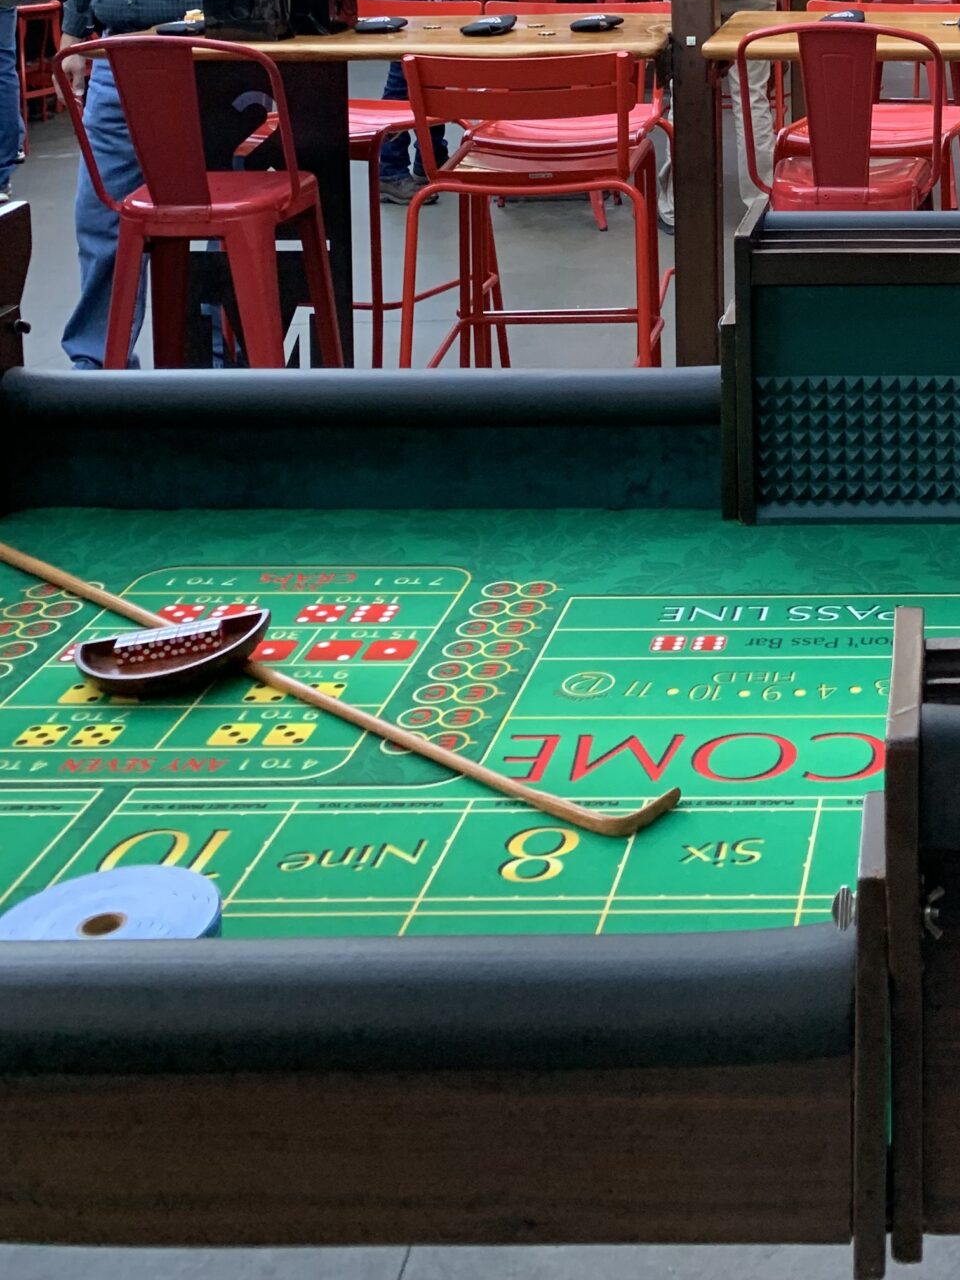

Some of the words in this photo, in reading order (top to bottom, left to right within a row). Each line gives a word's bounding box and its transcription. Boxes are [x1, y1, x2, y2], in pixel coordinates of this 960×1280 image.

[185, 576, 216, 586] TO
[220, 576, 238, 587] 7
[258, 572, 357, 584] CRAPS
[393, 576, 422, 586] TO
[428, 576, 444, 587] 7
[194, 595, 225, 604] TO
[230, 595, 260, 605] 15
[334, 595, 365, 604] TO
[372, 595, 400, 605] 15
[658, 605, 771, 623] LINE
[350, 630, 382, 639] TO
[389, 630, 418, 640] 15
[745, 636, 783, 650] Bar
[791, 636, 840, 650] Pass
[847, 634, 894, 650] on't
[293, 669, 325, 679] TO
[332, 669, 350, 680] 9
[712, 670, 797, 685] FIELD
[570, 673, 607, 695] 12
[623, 679, 654, 698] 11
[687, 683, 722, 702] 10
[761, 683, 783, 703] 9
[816, 682, 838, 700] 4
[70, 711, 105, 722] TO
[260, 710, 293, 720] TO
[302, 710, 320, 721] 9
[501, 730, 887, 784] COME
[57, 757, 157, 774] SEVEN
[161, 757, 231, 773] ANY
[260, 758, 293, 769] TO
[300, 758, 320, 771] 4
[276, 838, 428, 872] Nine
[497, 825, 580, 883] 8
[678, 836, 765, 868] Six
